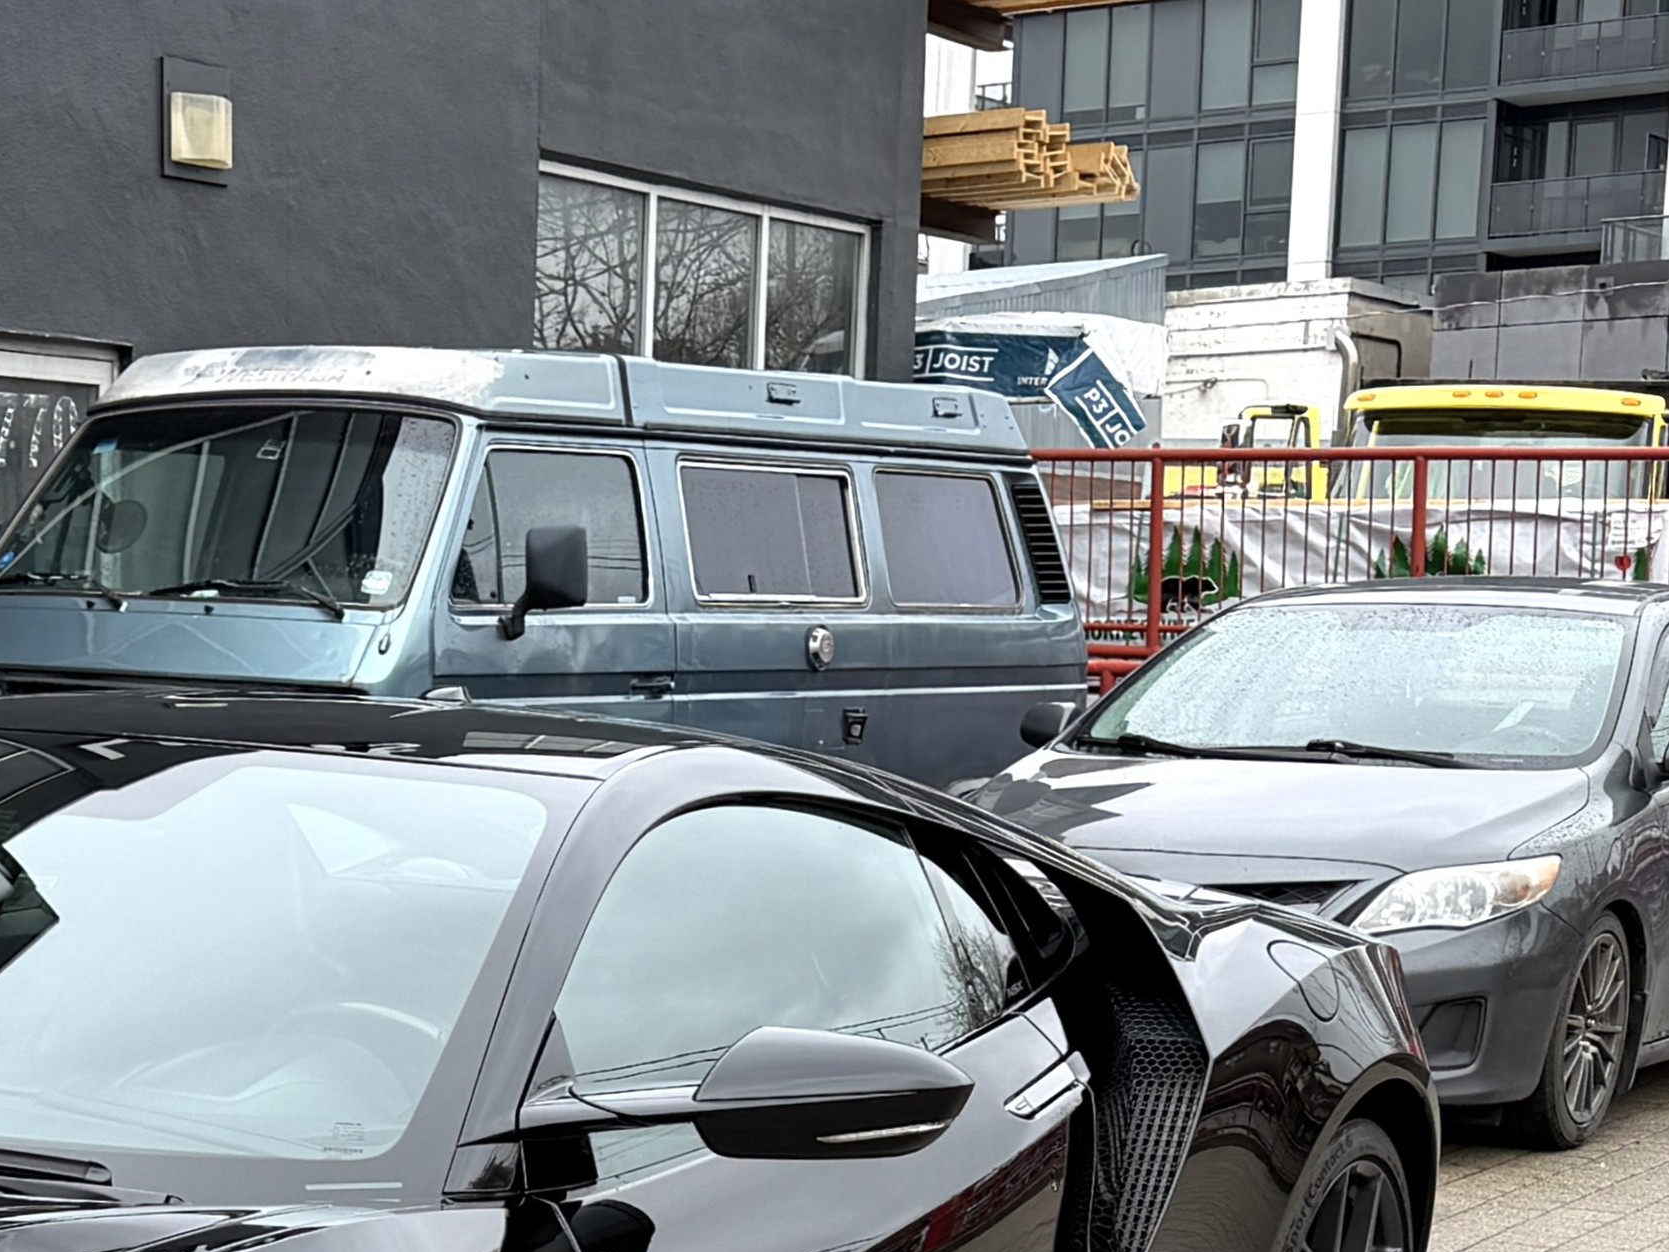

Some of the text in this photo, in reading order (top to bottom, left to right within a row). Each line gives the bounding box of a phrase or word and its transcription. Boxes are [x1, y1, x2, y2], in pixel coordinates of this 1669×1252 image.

[932, 352, 995, 373] JOIST
[215, 367, 347, 384] WESTFALIA
[1083, 387, 1109, 414] P3
